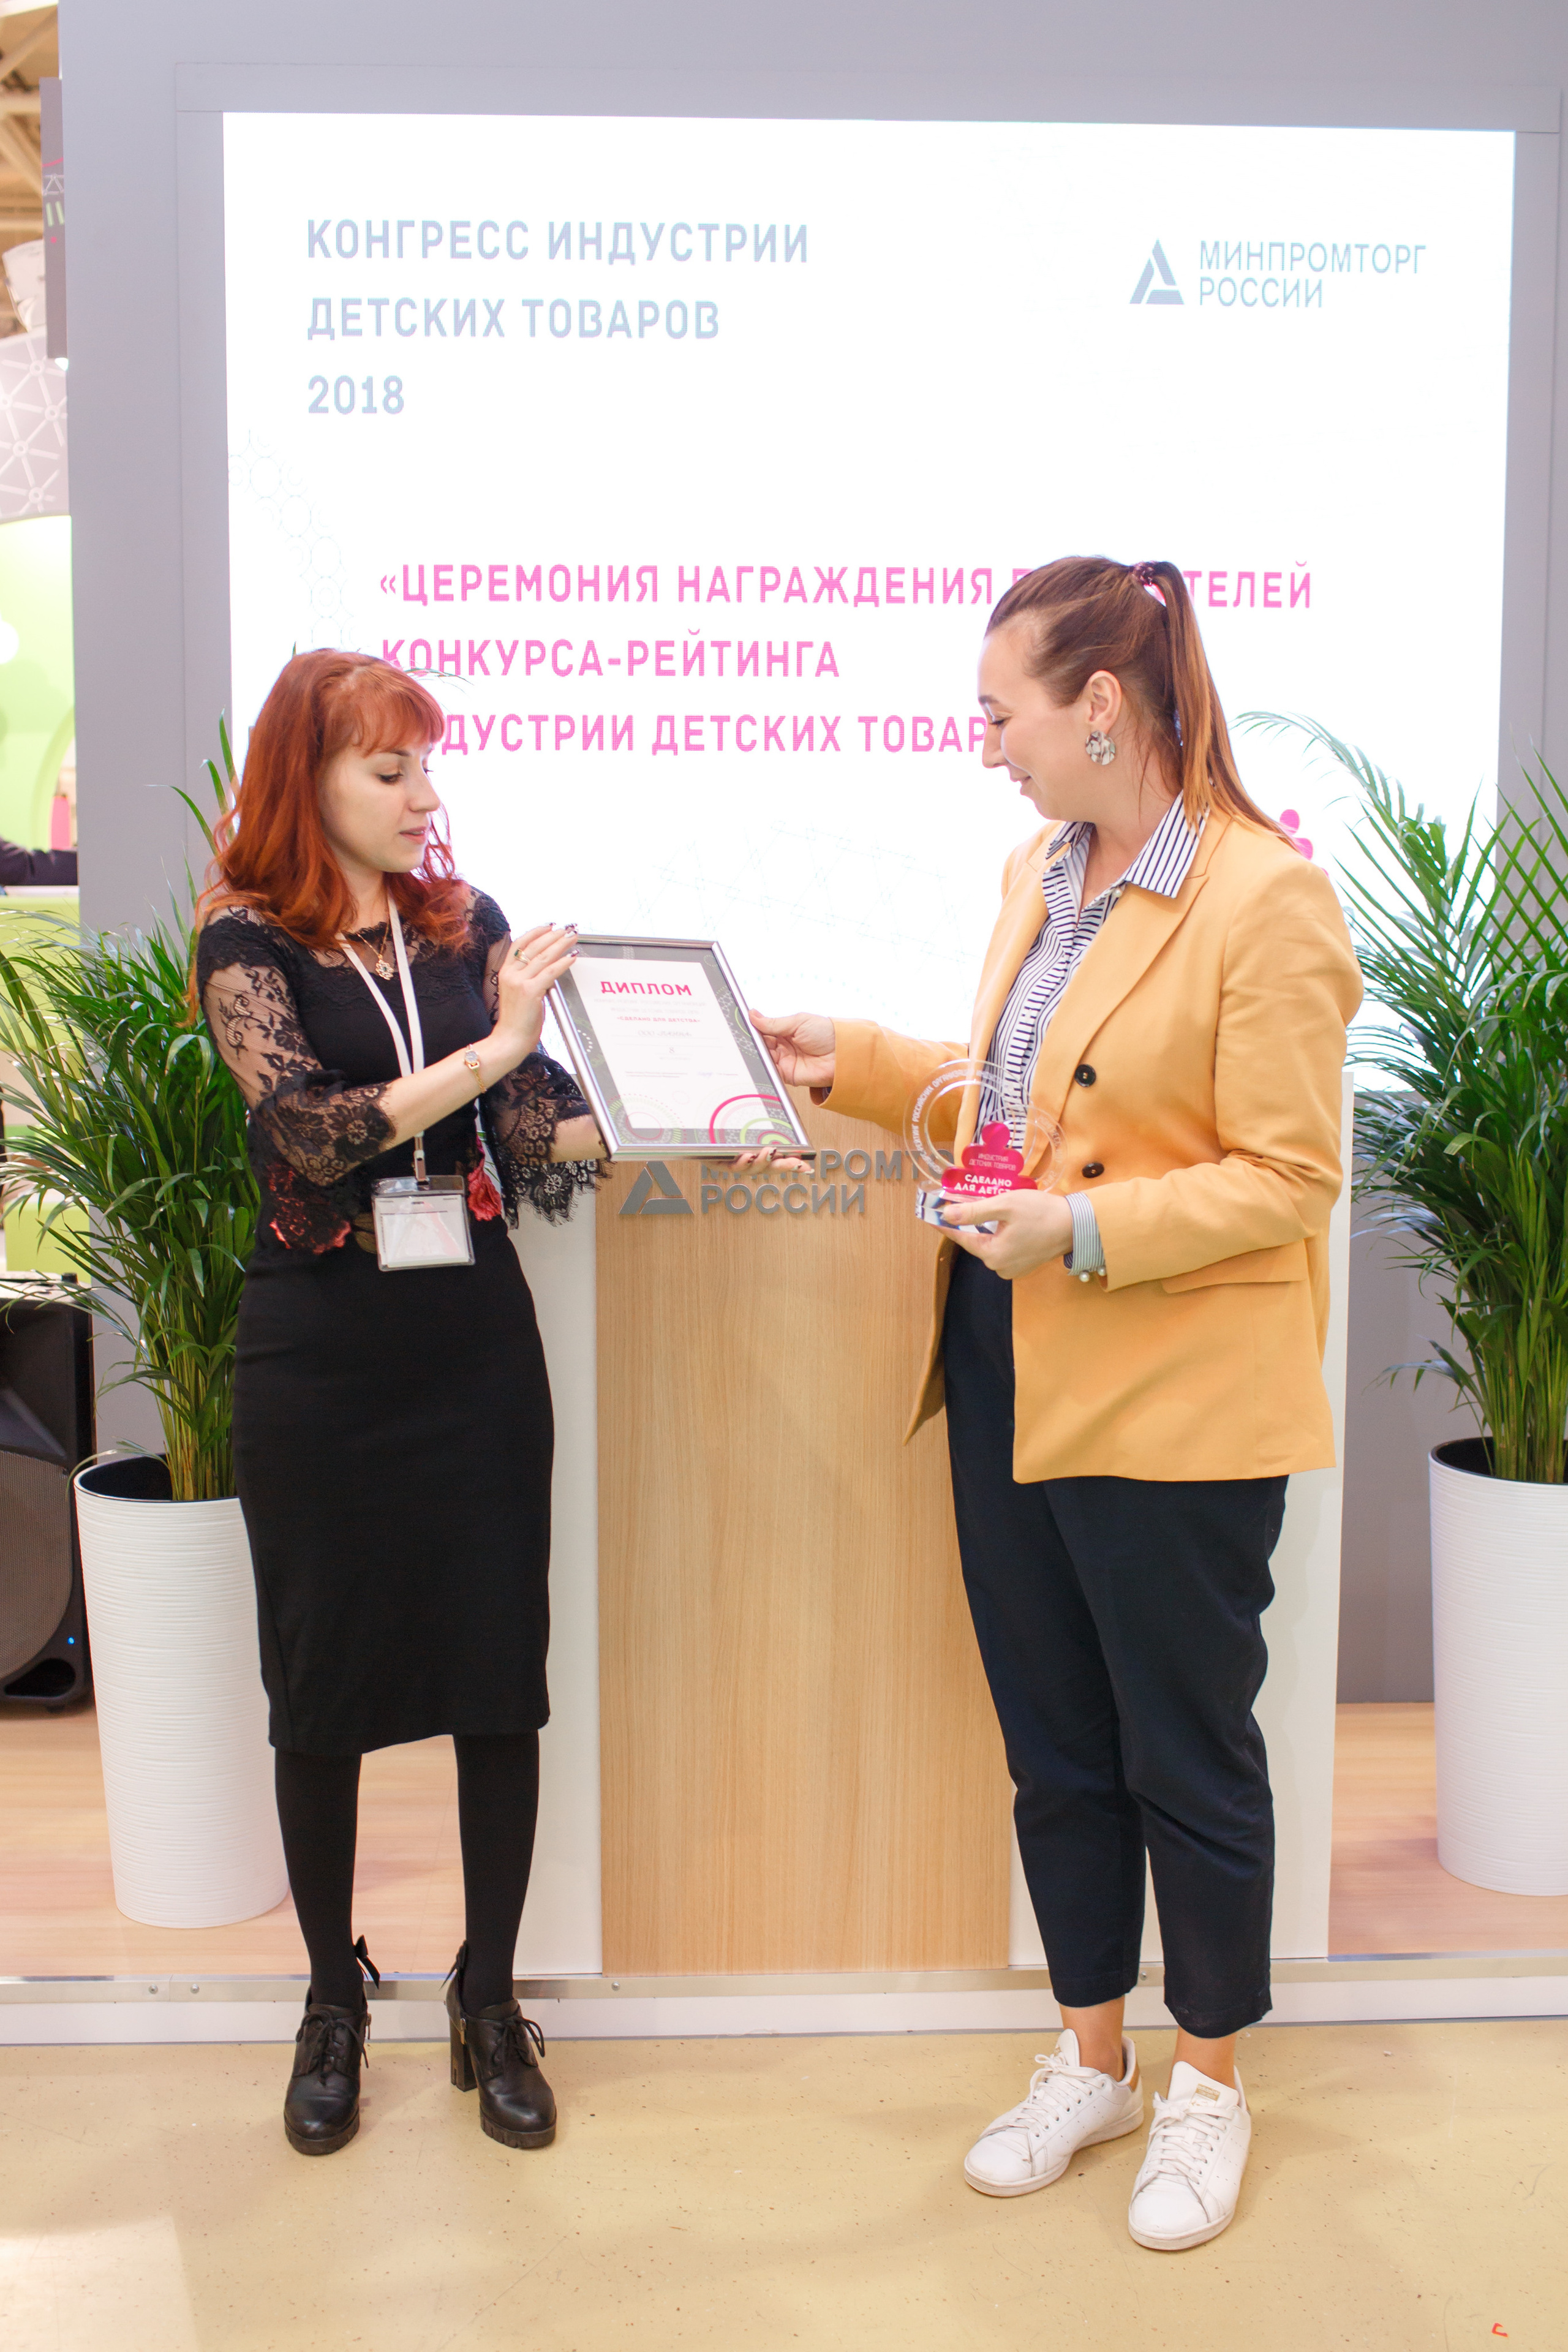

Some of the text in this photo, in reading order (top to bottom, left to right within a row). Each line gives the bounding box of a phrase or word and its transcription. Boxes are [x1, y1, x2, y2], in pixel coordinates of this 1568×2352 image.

[308, 219, 807, 265] КОНГРЕСС ИНДУСТРИИ
[1200, 241, 1426, 273] МИНПРОМТОРГ
[1200, 277, 1322, 307] РОССИИ
[307, 297, 718, 340] ДЕТСКИХ ТОВАРОВ
[308, 375, 404, 415] 2018
[380, 564, 657, 606] «ЦЕРЕМОНИЯ
[679, 565, 992, 608] НАГРАЖДЕНИЯ
[383, 629, 839, 677] КОНКУРСА-РЕЙТИНГА
[442, 714, 987, 756] ДУСТРИИ ДЕТСКИХ ТОВАР
[601, 981, 692, 995] ДИПЛОМ
[701, 1183, 864, 1214] РОССИИ
[954, 1183, 1011, 1194] ДЛЯ ДЕТС
[965, 1174, 1012, 1187] СДЕЛАНО
